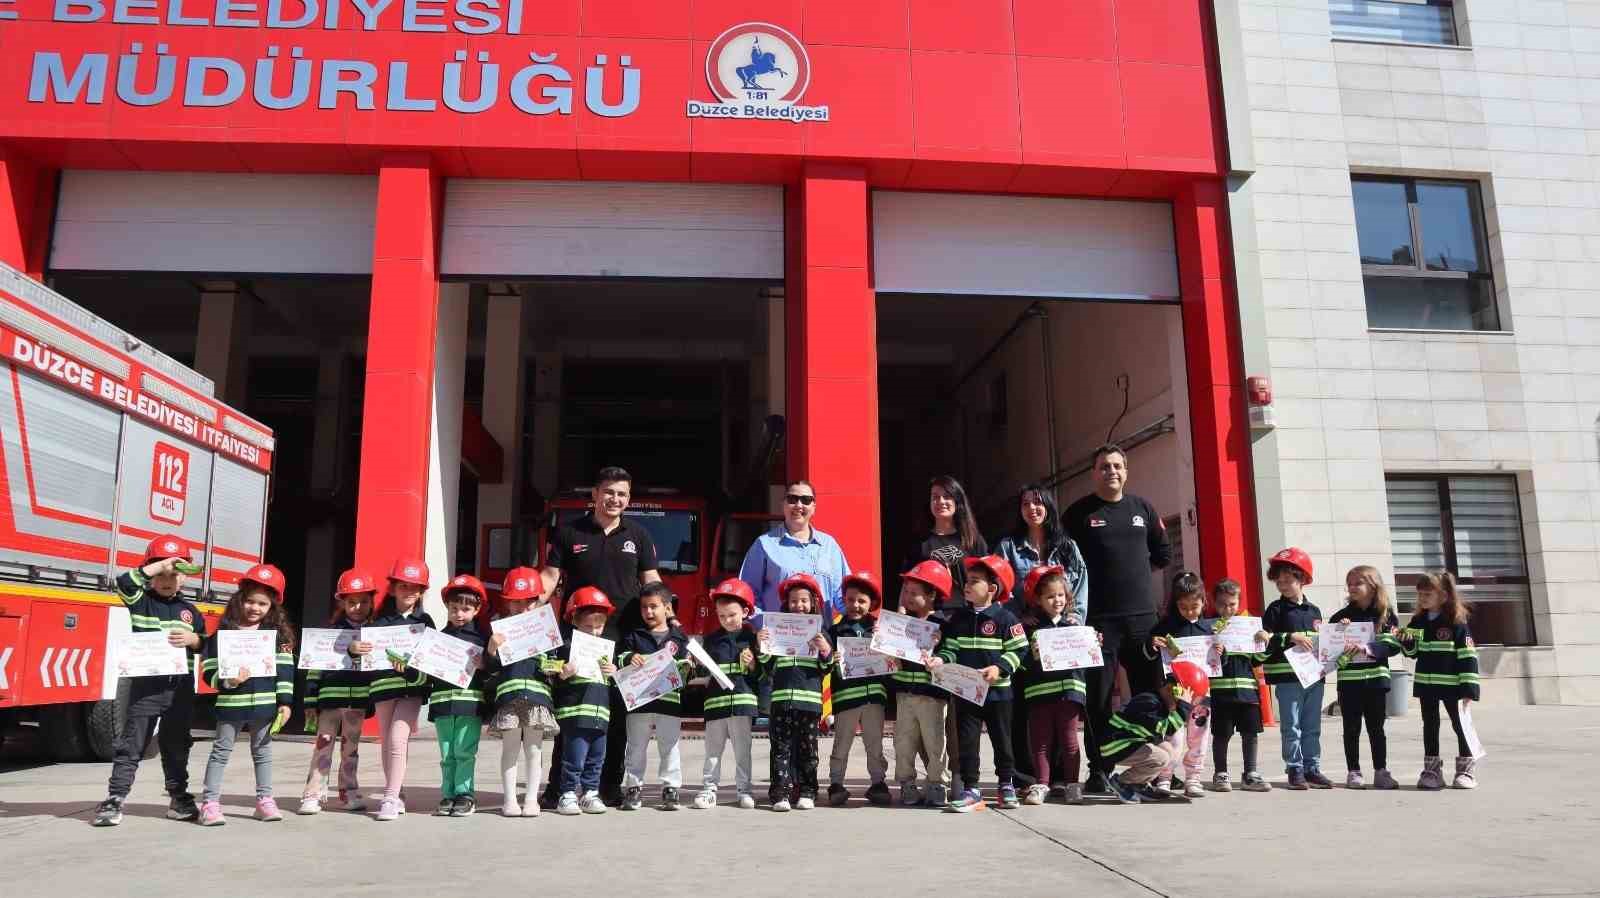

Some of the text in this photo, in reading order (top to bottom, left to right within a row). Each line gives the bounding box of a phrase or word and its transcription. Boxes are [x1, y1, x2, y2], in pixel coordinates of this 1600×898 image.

[27, 41, 641, 117] MÜDÜRLÜĞÜ
[744, 105, 827, 120] Belediyesi
[13, 336, 260, 465] DÜZCE BELEDİYESİ İTFAİYESİ
[159, 452, 184, 493] 112
